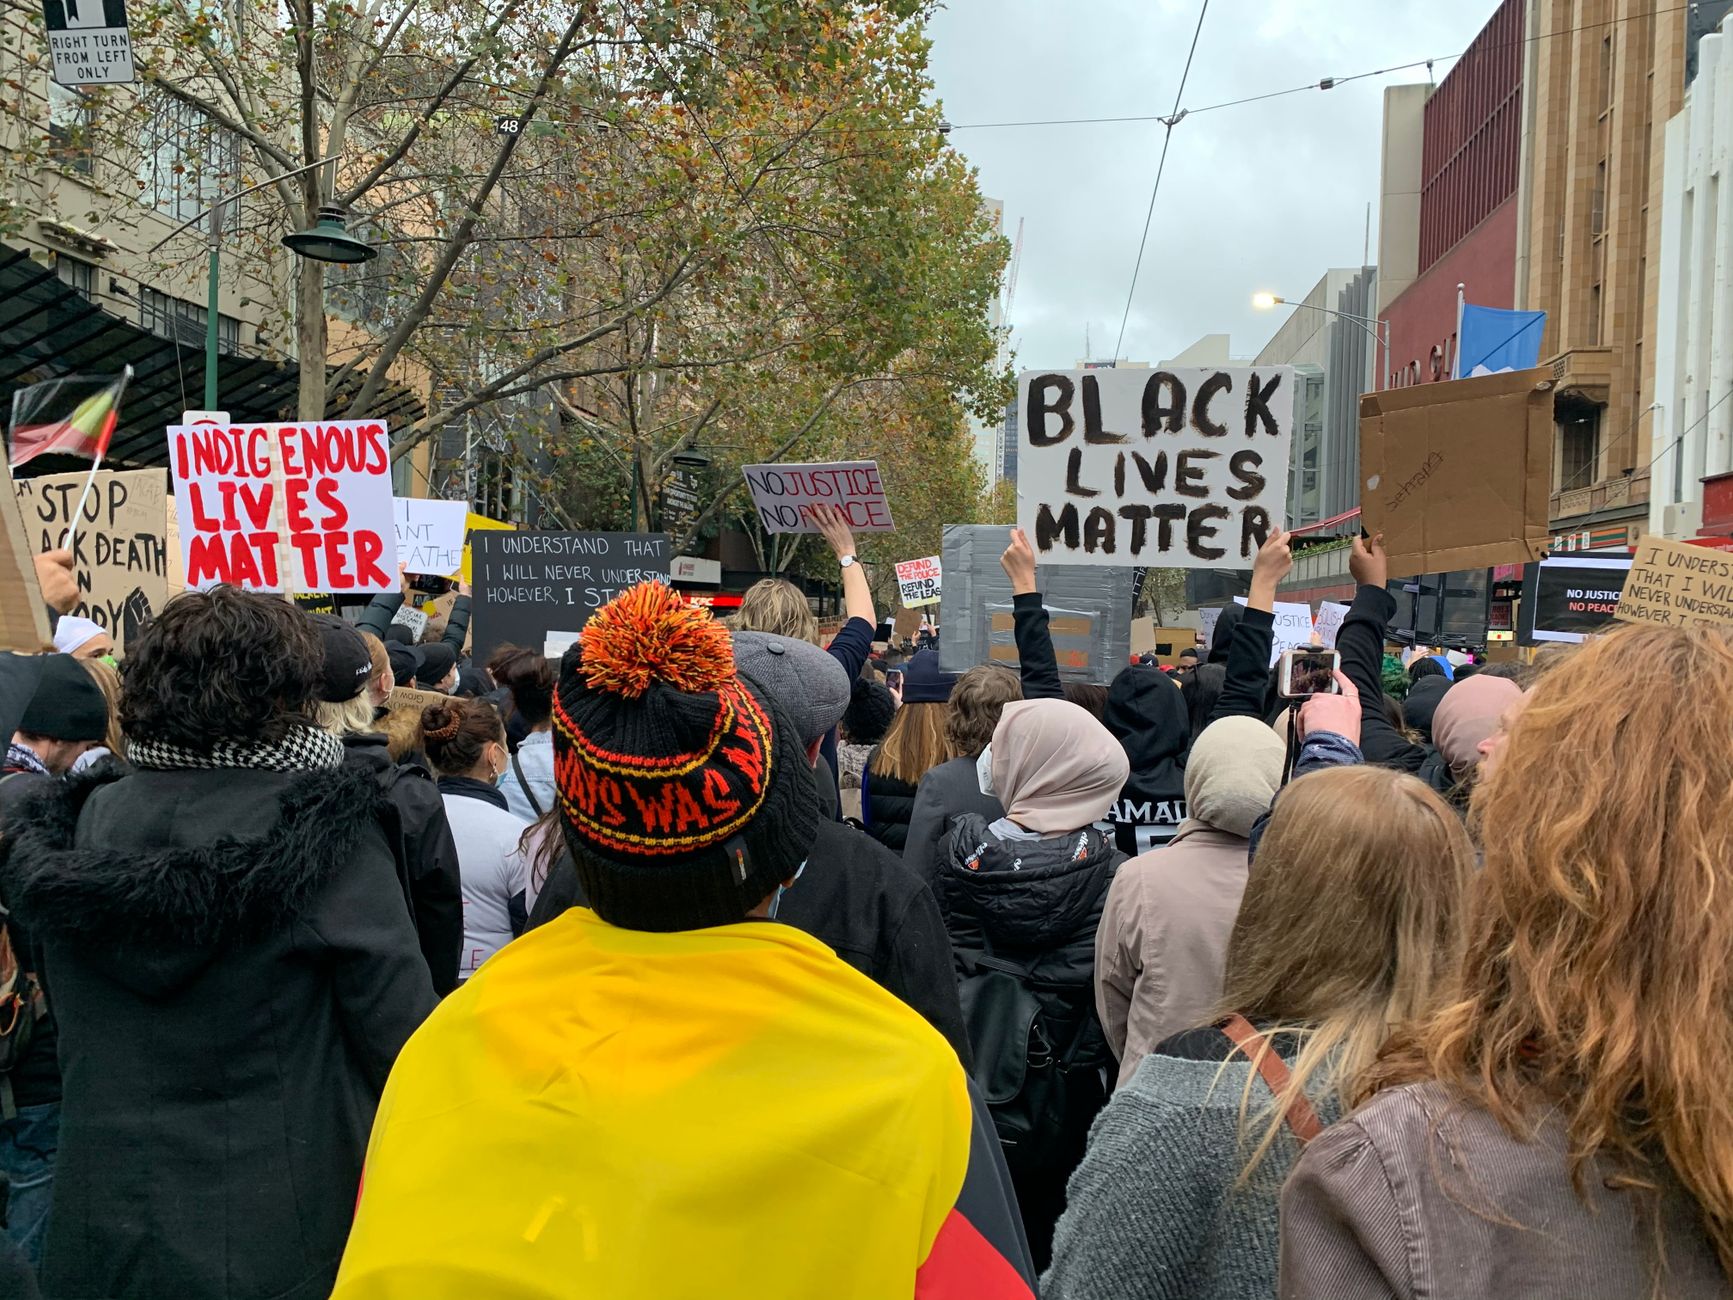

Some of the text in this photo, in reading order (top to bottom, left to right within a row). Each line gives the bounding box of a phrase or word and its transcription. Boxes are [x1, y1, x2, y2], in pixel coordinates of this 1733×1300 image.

[52, 34, 127, 49] RIGHT TURN
[56, 50, 126, 64] FROM LEFT
[77, 66, 109, 79] ONLY
[500, 119, 519, 133] 48
[1027, 371, 1282, 447] BLACK
[176, 424, 388, 480] INDIGENOUS
[1065, 446, 1266, 501] LIVES
[746, 468, 885, 502] NO JUSTICE
[37, 480, 128, 528] STOP
[188, 477, 349, 533] LIVES
[406, 500, 410, 522] I
[760, 501, 892, 529] NO PACE
[1035, 502, 1272, 561] MATTER
[484, 536, 489, 553] I
[502, 536, 609, 555] UNDERSTAND
[624, 540, 664, 557] THAT
[1644, 547, 1663, 566] I
[187, 529, 392, 589] MATTER
[897, 559, 931, 574] DEFUND
[485, 564, 490, 581] I
[503, 563, 538, 581] WILL
[545, 565, 595, 582] NEVER
[602, 568, 672, 586] UNDERSTAND
[899, 568, 940, 581] THE POLICE
[1635, 568, 1675, 588] THAT
[1681, 576, 1694, 591] I
[487, 586, 624, 607] HOWEVER, I ST
[901, 579, 935, 594] REFUND
[904, 591, 919, 600] THE
[1567, 589, 1583, 598] NO
[1629, 584, 1671, 605] NEVER
[690, 597, 715, 606] KFC
[1569, 602, 1585, 612] NO
[624, 768, 742, 833] WAS
